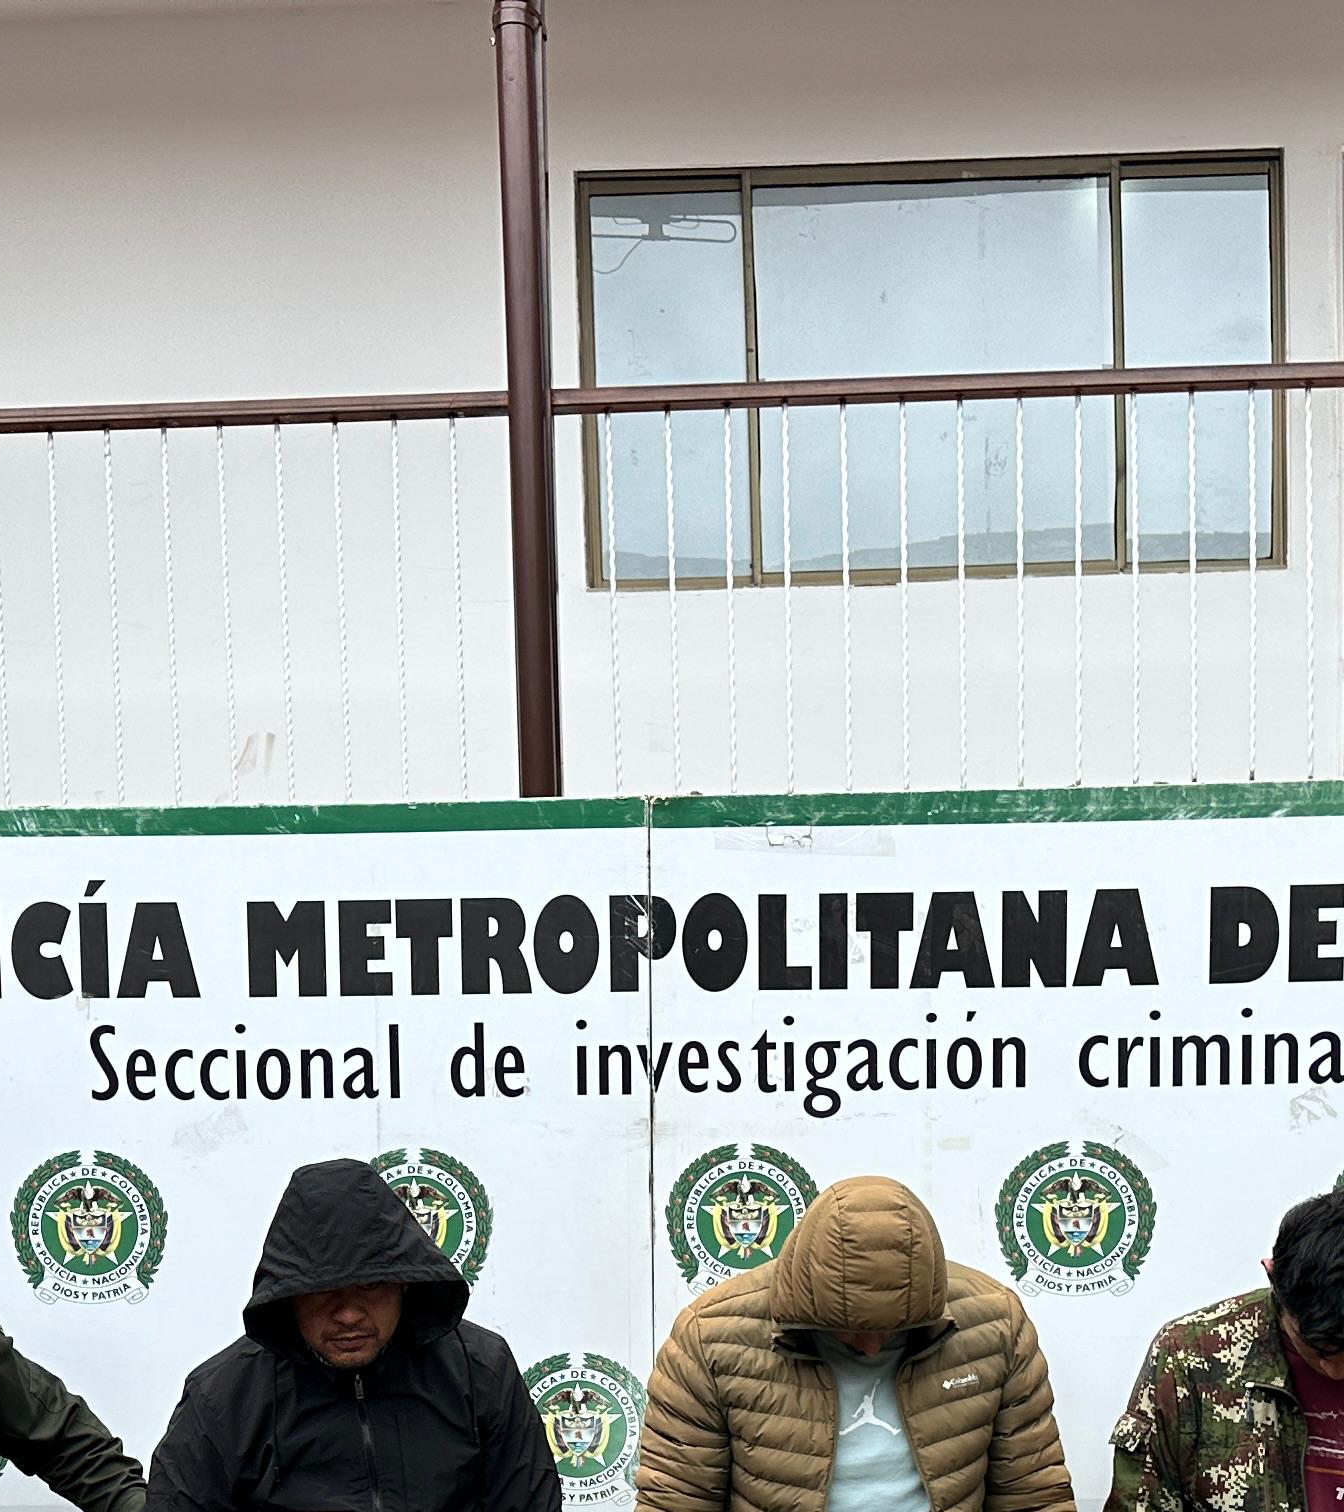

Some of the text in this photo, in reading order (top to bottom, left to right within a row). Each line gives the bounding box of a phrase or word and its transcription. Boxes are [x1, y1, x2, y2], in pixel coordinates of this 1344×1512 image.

[247, 887, 1160, 999] METROPOLITANA
[90, 1023, 401, 1101] Seccional
[451, 1022, 525, 1098] de
[576, 1011, 1026, 1119] investigación
[738, 1161, 755, 1170] DE
[81, 1168, 98, 1177] DE
[110, 1174, 149, 1236] COLOMBIA
[406, 1165, 474, 1233] DE COLOMBIA
[1069, 1158, 1086, 1167] DE
[1099, 1165, 1136, 1228] COLOMBIA
[91, 1250, 145, 1287] NACIONAL
[1075, 1241, 1132, 1278] NACIONAL
[52, 1282, 132, 1301] DIOS Y PATRIA
[1035, 1274, 1117, 1293] DIOS Y PATRIA
[570, 1370, 587, 1379] DE
[600, 1377, 638, 1438] COLOMBIA
[579, 1451, 632, 1488] NACIONAL
[579, 1484, 620, 1502] PATRIA
